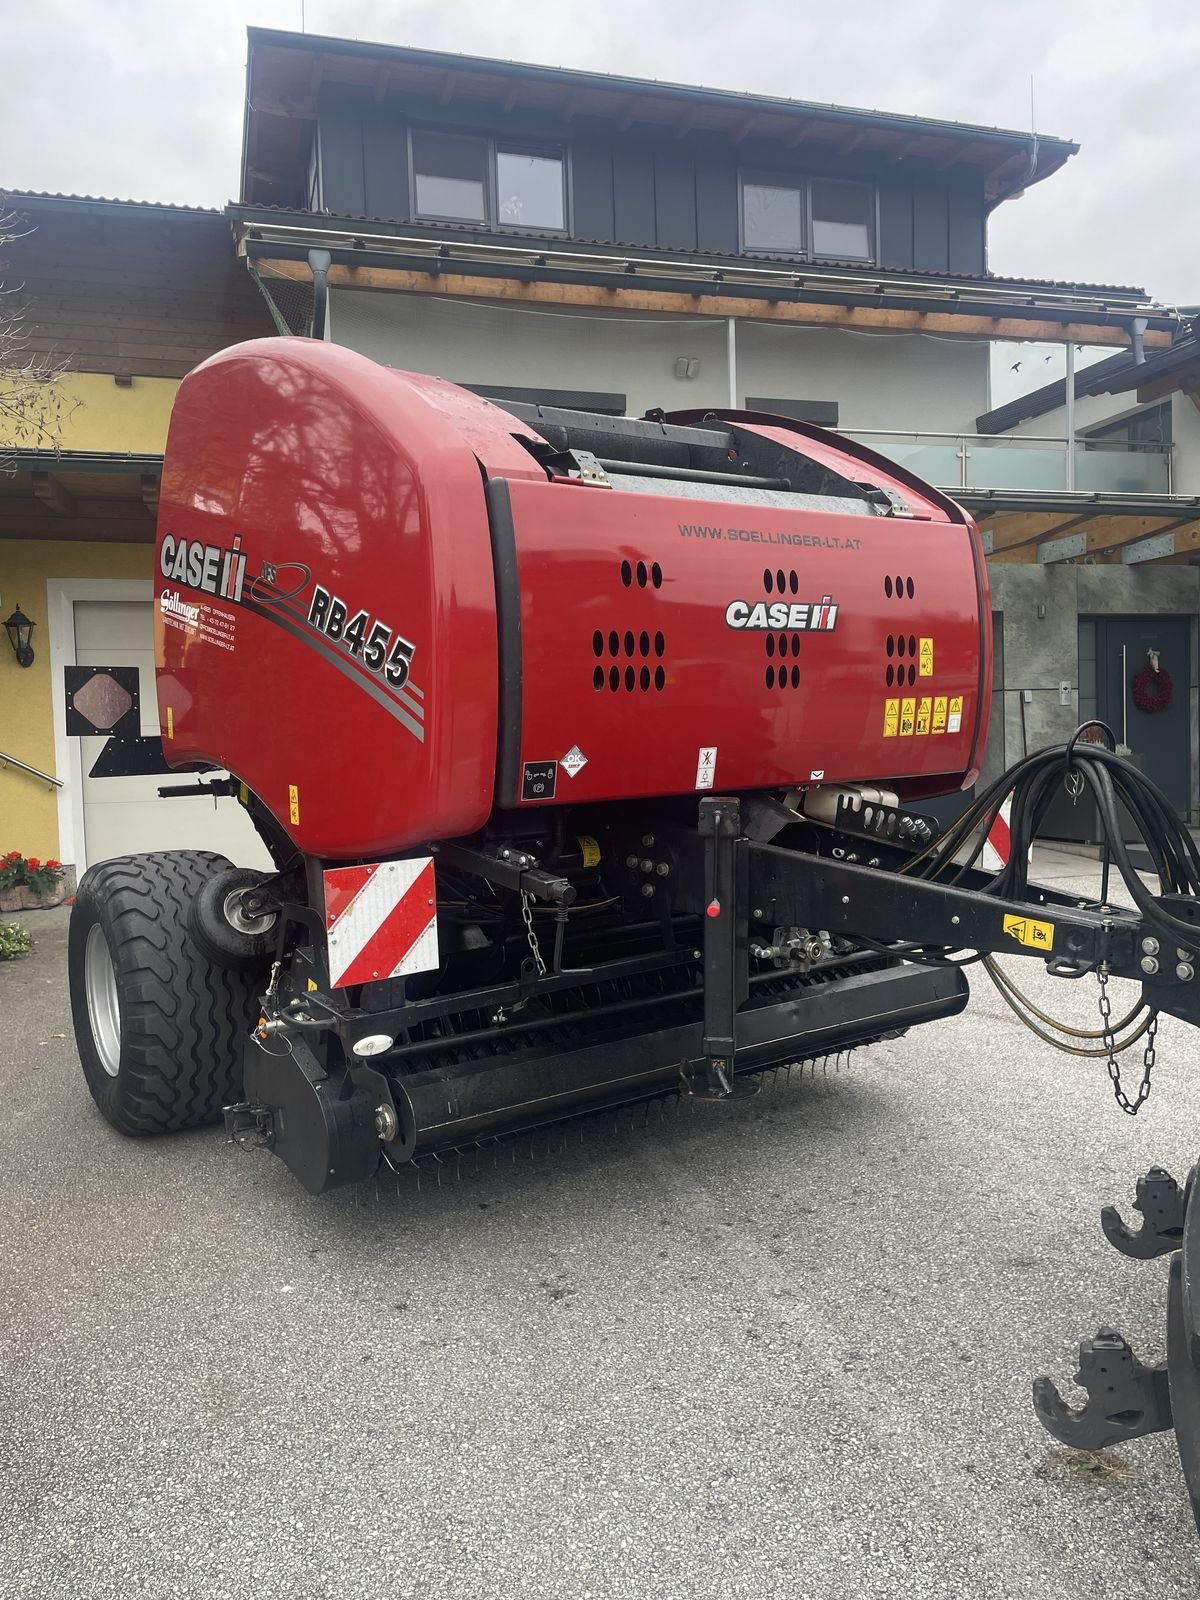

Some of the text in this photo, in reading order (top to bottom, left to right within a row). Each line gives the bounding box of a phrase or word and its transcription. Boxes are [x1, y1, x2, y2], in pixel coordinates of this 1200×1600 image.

[678, 524, 862, 550] WWW.SOELLINGER-LT.AT
[160, 589, 200, 622] Söllinger
[307, 584, 416, 690] RB455
[567, 754, 581, 763] OK
